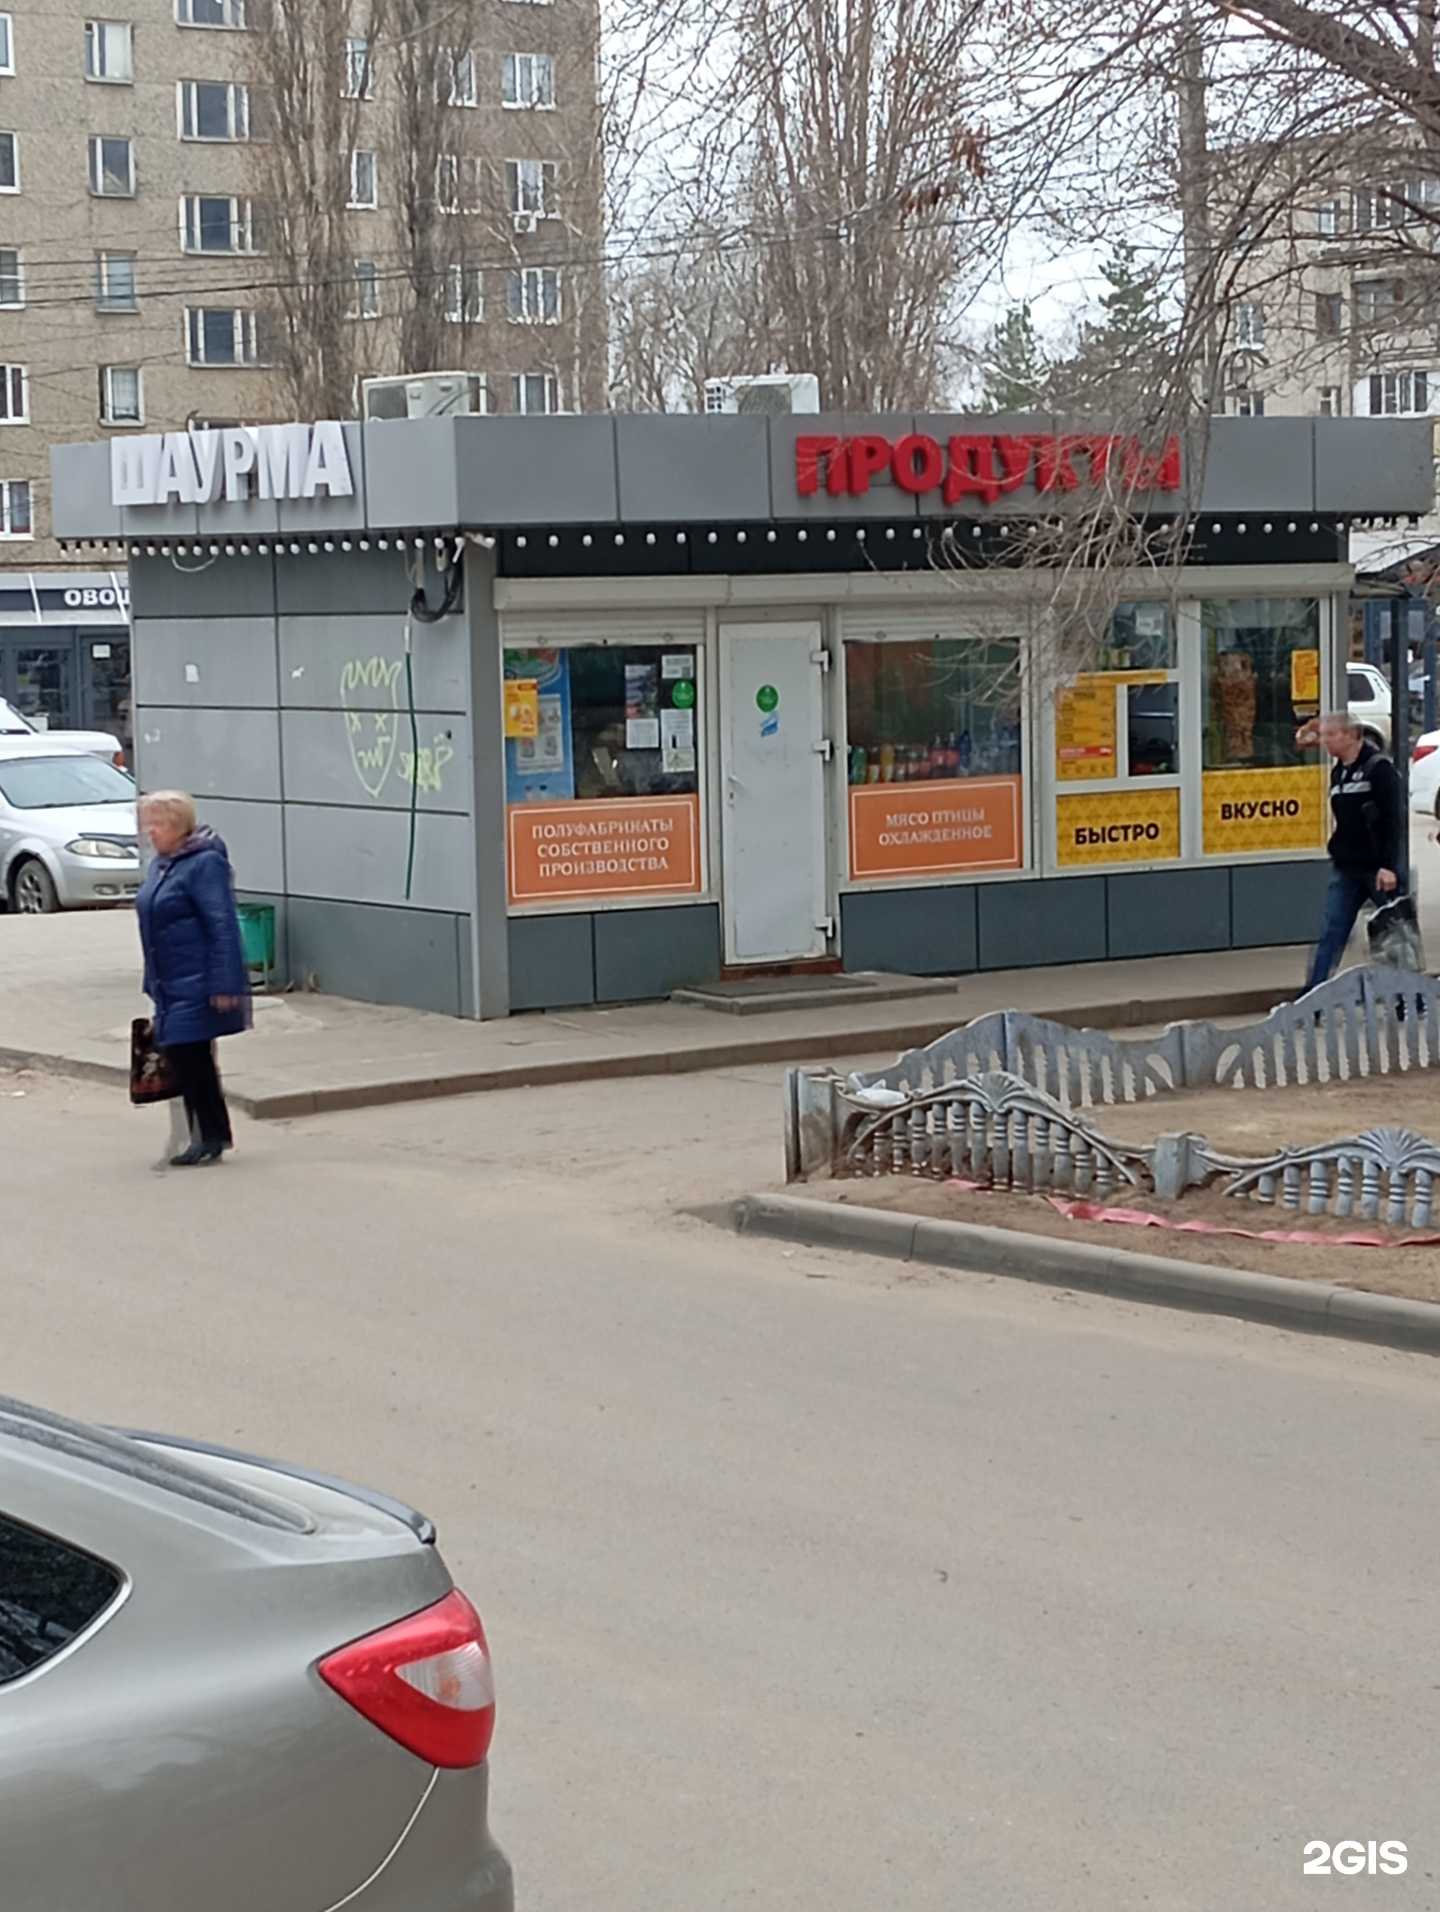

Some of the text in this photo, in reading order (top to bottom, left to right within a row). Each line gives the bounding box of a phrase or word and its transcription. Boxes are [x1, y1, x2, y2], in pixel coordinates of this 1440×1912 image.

[110, 419, 353, 506] ШАУРМА
[886, 808, 985, 827] МЯСО ПТИЦЫ
[1221, 799, 1300, 821] ВКУСНО
[532, 817, 673, 840] ПОЛУФАБРИКАТЫ
[879, 825, 992, 846] ОХЛАЖДЕННОЕ
[1074, 822, 1160, 846] БЫСТРО
[537, 837, 670, 858] СОБСТВЕННОГО
[539, 856, 669, 878] ПРОИЗВОДСТВА
